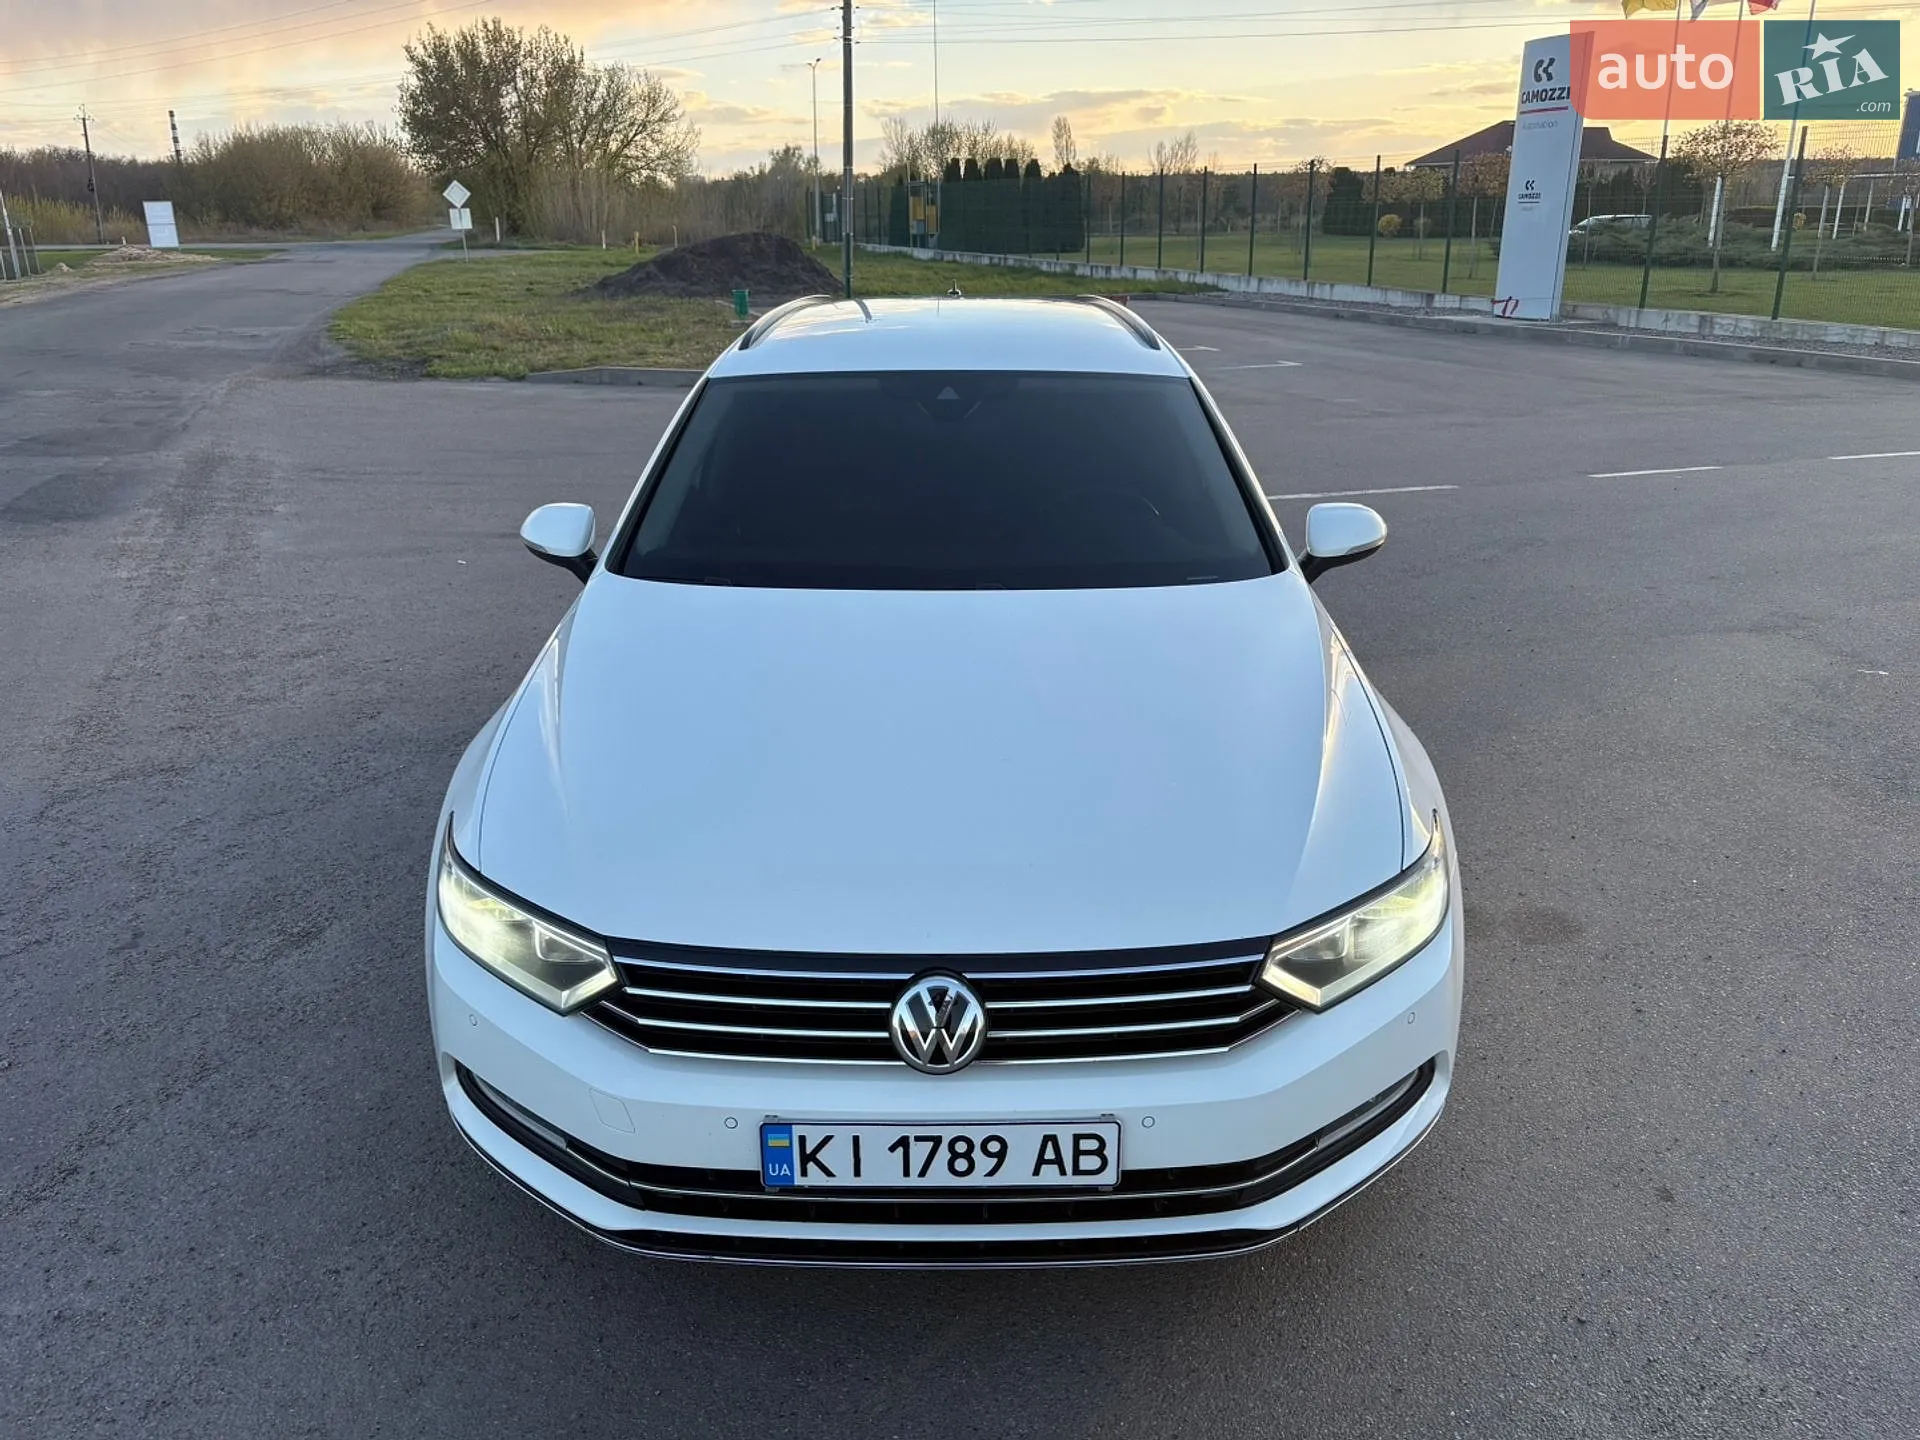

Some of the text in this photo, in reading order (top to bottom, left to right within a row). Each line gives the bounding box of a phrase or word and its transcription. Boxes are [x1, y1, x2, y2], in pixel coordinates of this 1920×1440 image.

[1521, 86, 1571, 104] CAMOZZI
[798, 1133, 1109, 1178] KI 1789 AB
[768, 1163, 791, 1177] UA
